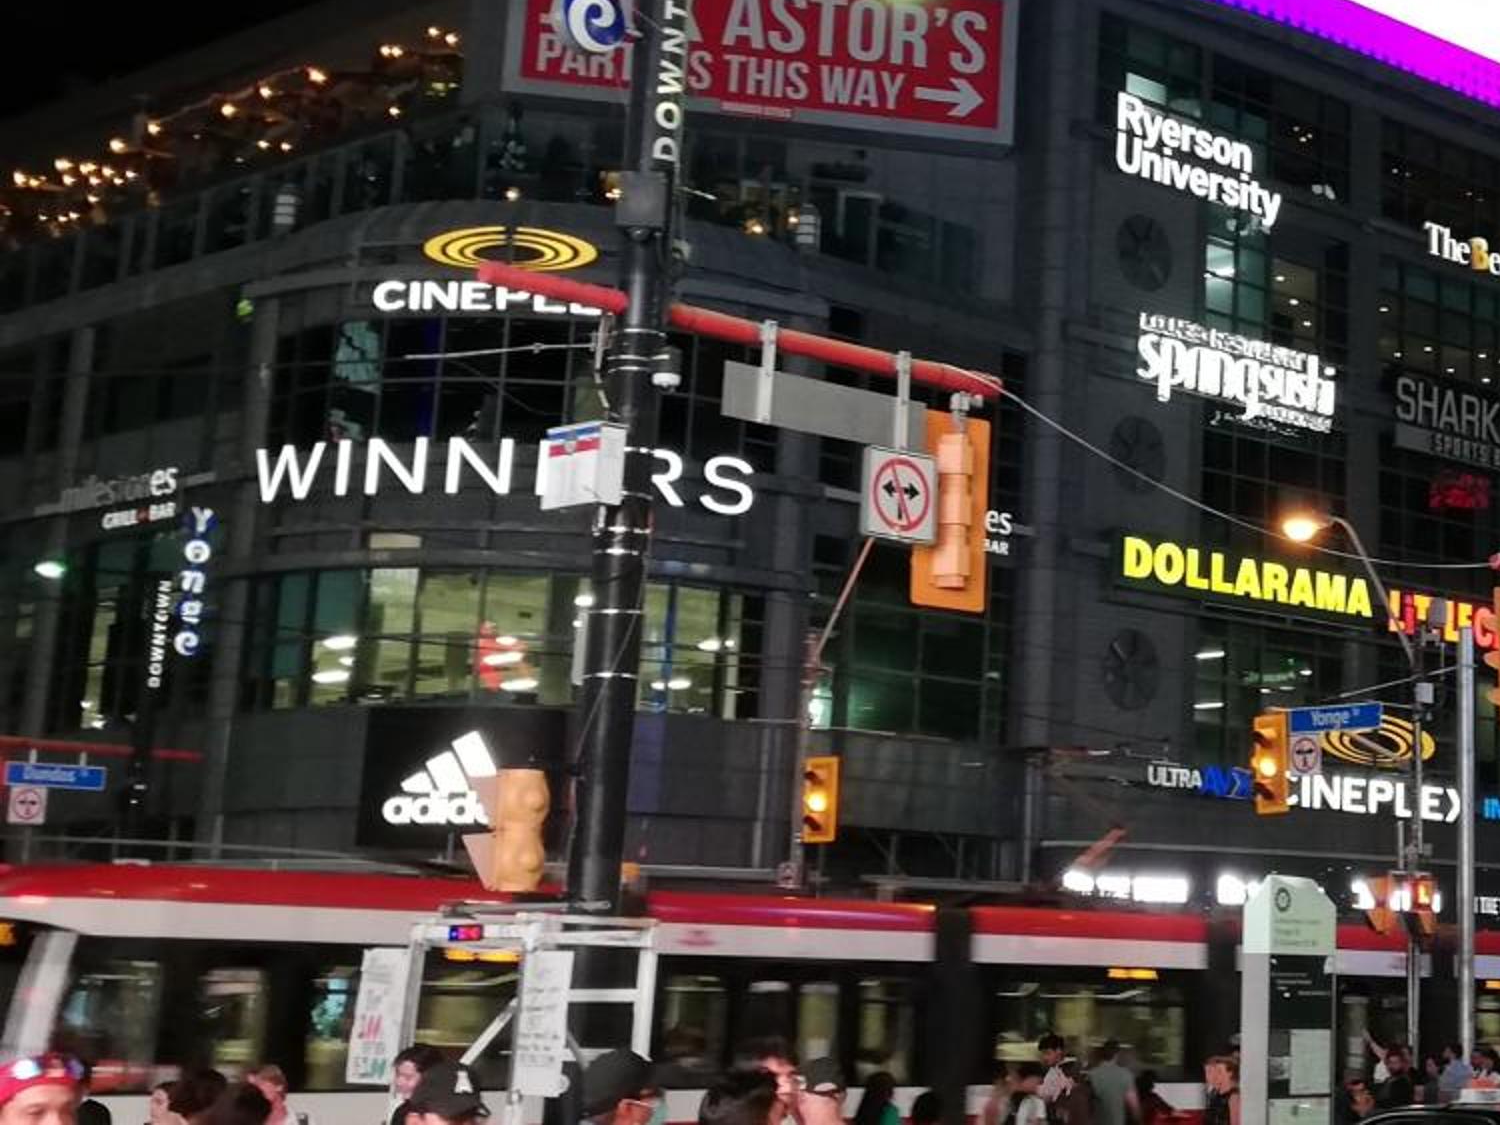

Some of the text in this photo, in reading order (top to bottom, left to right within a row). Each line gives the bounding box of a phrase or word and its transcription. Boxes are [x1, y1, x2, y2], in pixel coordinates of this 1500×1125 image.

[723, 53, 809, 104] THIS
[820, 63, 908, 110] WAY
[1117, 91, 1253, 174] Ryerson
[1115, 130, 1282, 228] University
[372, 280, 603, 316] CINEPL
[1396, 376, 1500, 444] SHARK
[256, 436, 755, 515] WINNRS
[1123, 536, 1373, 617] DOLLARAMA
[382, 790, 491, 825] adid
[1147, 765, 1203, 790] ULTRA
